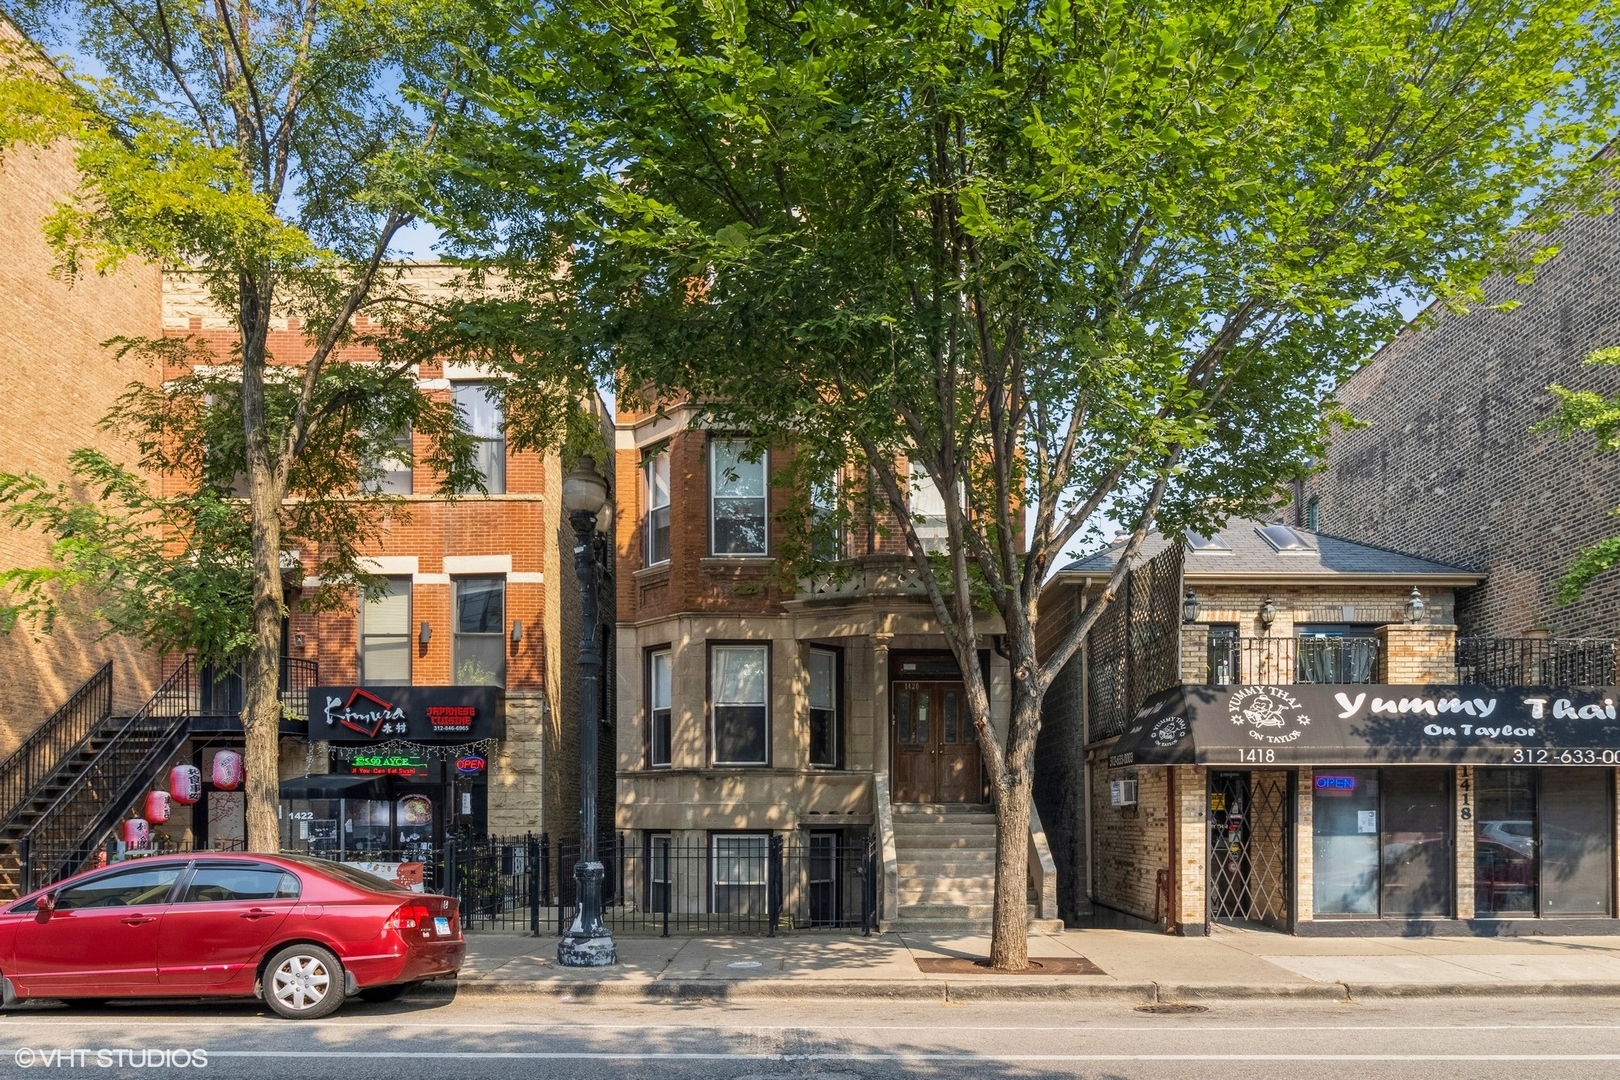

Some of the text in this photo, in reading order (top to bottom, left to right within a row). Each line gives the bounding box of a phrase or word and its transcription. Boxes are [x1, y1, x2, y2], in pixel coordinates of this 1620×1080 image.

[904, 682, 920, 690] 1420
[1228, 685, 1302, 712] YUMMY THAI
[323, 696, 405, 724] Kimura
[427, 706, 475, 717] JAPANESE
[1334, 692, 1617, 719] Yummy Thai
[431, 716, 471, 725] CUISINE
[1153, 716, 1176, 730] YUMMY
[1249, 730, 1302, 743] ON TAYLOR
[1423, 724, 1536, 738] On Taylor
[383, 757, 409, 766] AYCE
[1238, 749, 1275, 763] 1418
[456, 759, 485, 770] OPEN
[1316, 777, 1353, 788] OPEN
[1460, 765, 1472, 820] 1418
[288, 811, 314, 820] 1422
